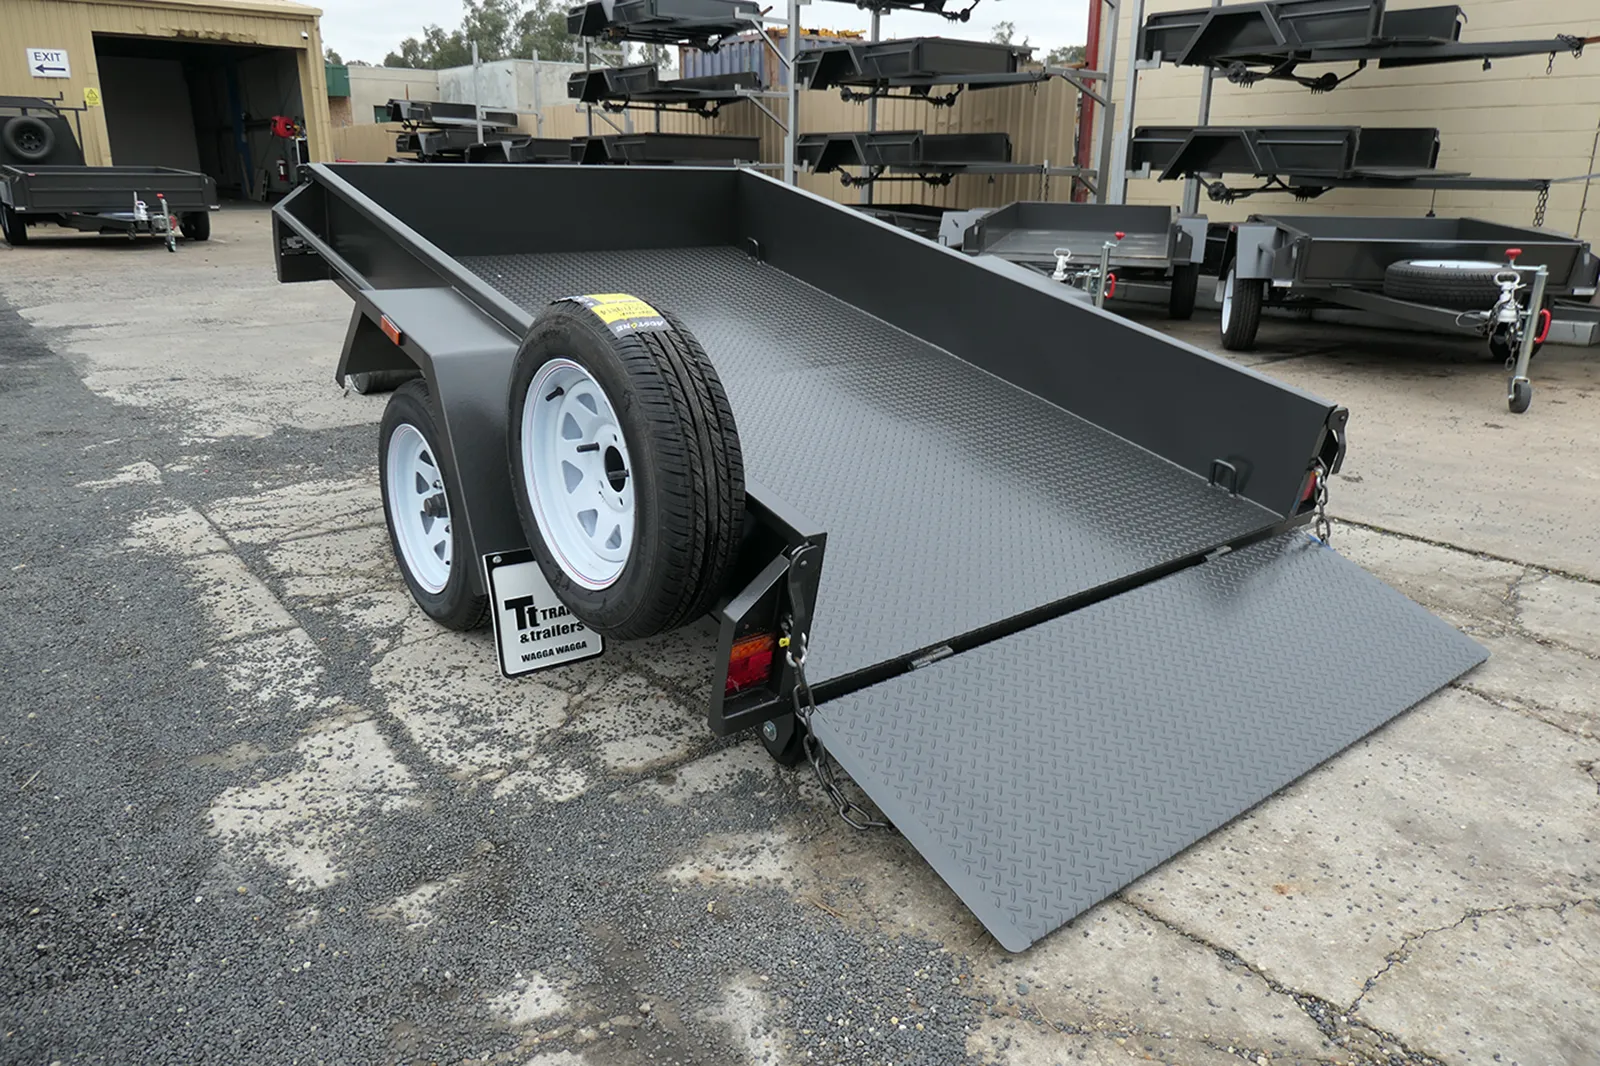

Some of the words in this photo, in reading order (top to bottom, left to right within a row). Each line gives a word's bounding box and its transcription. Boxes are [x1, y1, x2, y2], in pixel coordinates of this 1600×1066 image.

[33, 52, 61, 61] EXIT
[521, 649, 554, 662] WAGGA
[555, 641, 587, 655] WAGGA
